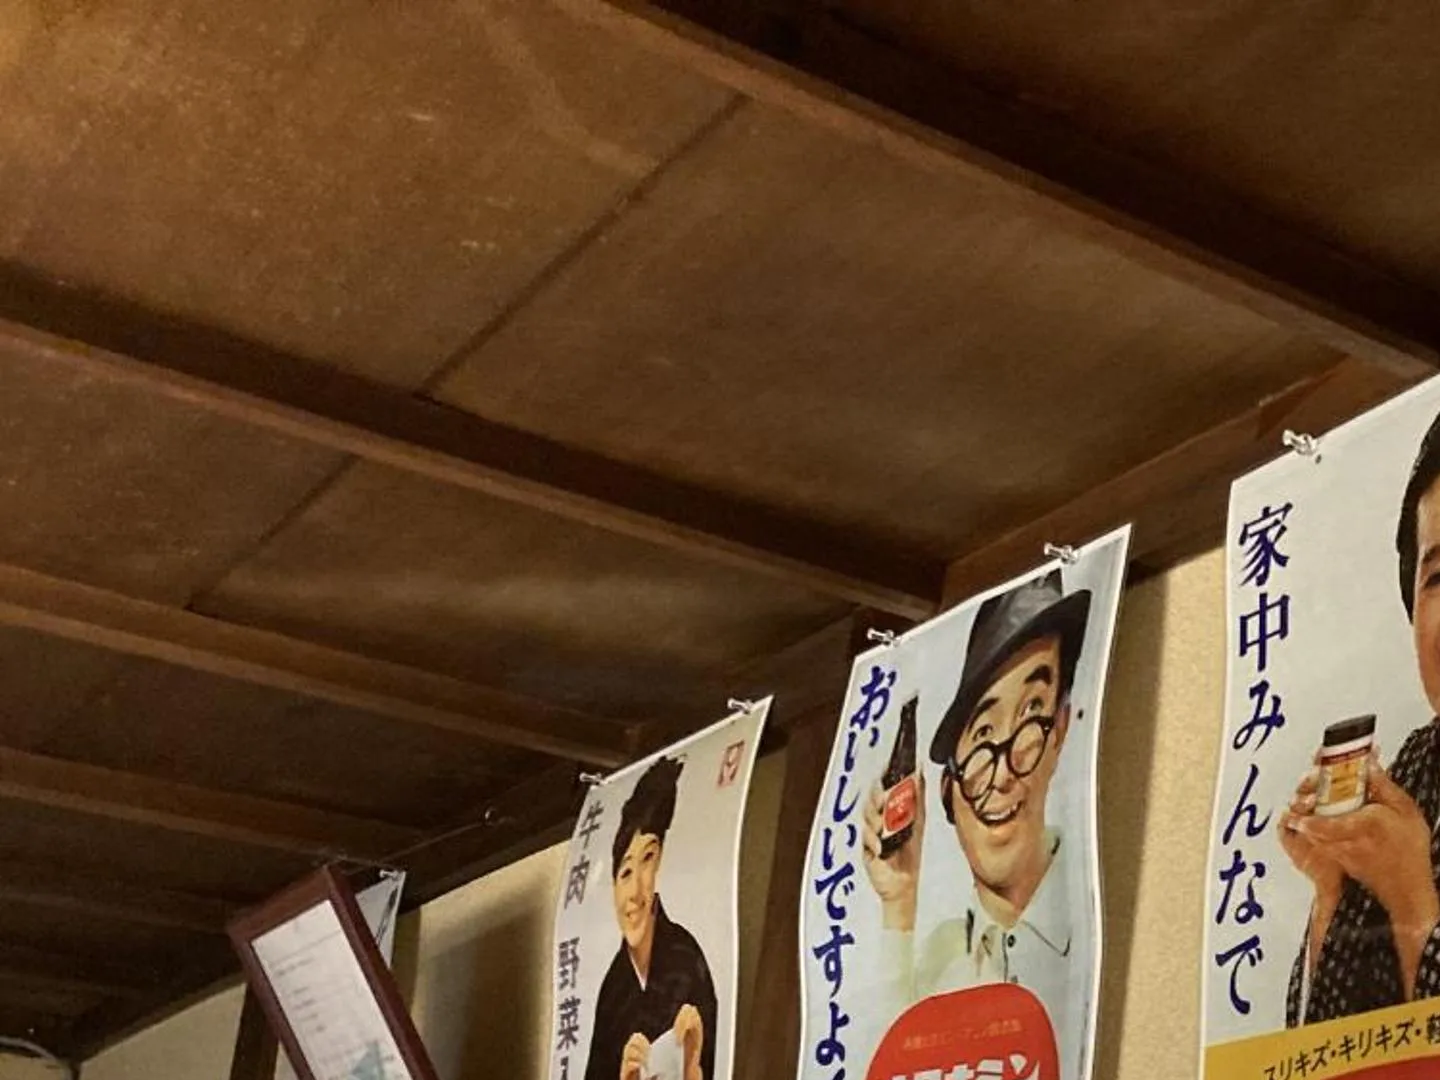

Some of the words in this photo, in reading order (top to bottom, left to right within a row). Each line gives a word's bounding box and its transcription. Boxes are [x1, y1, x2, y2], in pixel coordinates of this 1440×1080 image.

[565, 801, 604, 909] 牛肉
[1216, 503, 1293, 1015] 家中みんなで
